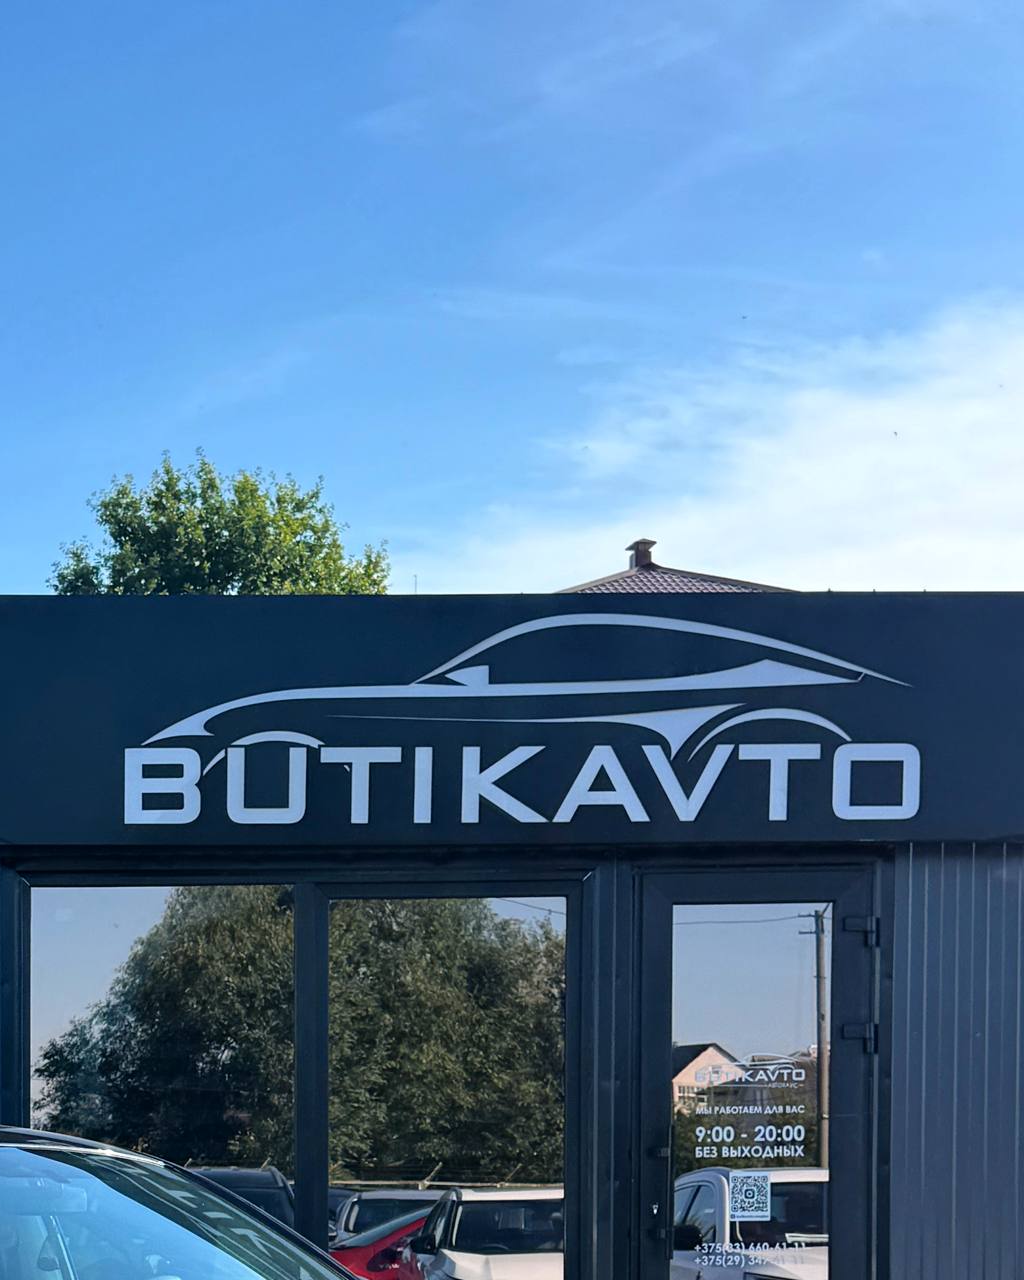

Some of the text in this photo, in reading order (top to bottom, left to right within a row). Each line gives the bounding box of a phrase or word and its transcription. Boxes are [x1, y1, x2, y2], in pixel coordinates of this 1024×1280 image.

[124, 742, 921, 825] BUTIKAVTO
[696, 1105, 806, 1115] МЫ РАБОТАЕМ ДЛЯ ВАС
[695, 1126, 735, 1143] 9:00
[754, 1125, 806, 1142] 20:00
[695, 1145, 805, 1158] БЕЗ ВЫХОДНЫХ
[694, 1255, 746, 1268] +375(29)
